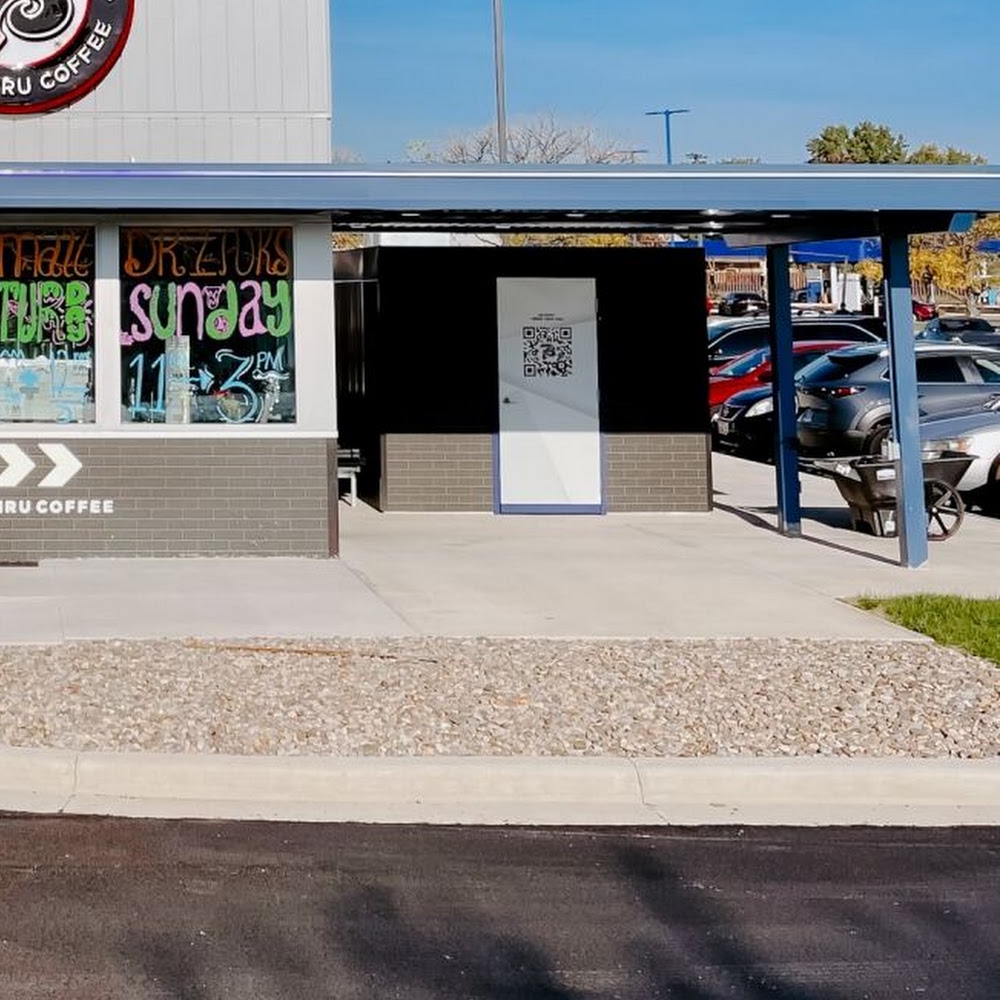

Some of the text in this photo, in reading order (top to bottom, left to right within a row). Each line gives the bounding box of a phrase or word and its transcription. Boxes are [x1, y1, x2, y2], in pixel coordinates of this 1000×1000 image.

[40, 18, 112, 89] COFFEE
[129, 347, 284, 423] 11 3 PM
[36, 499, 114, 514] COFFEE
